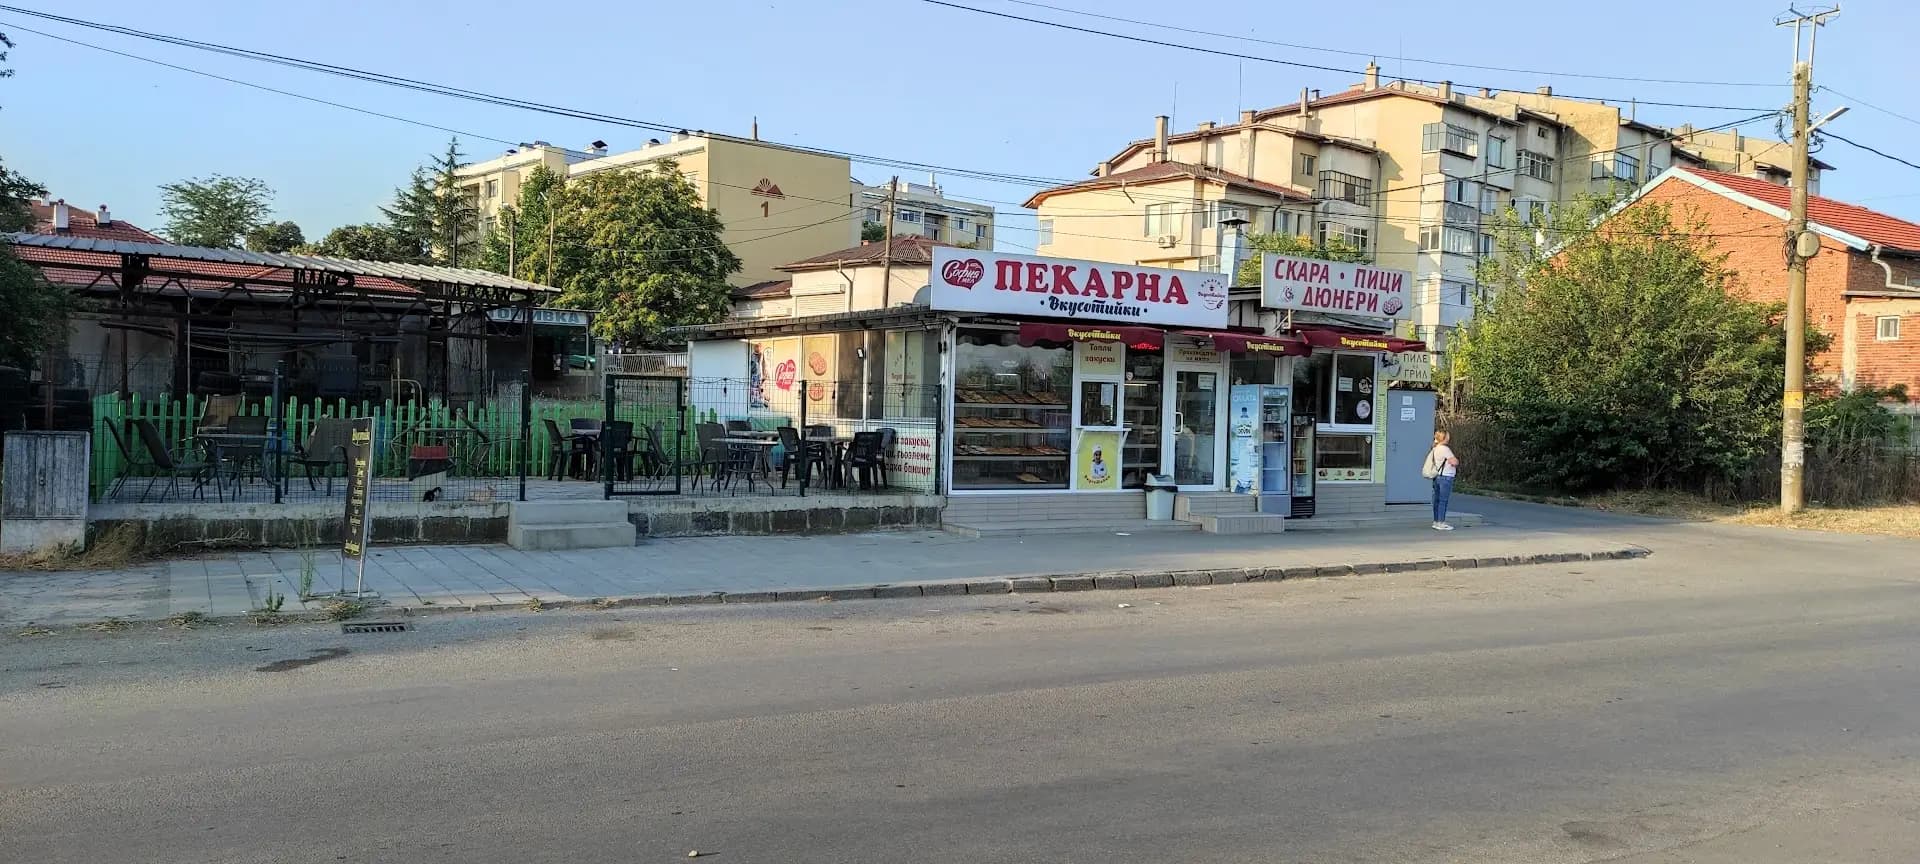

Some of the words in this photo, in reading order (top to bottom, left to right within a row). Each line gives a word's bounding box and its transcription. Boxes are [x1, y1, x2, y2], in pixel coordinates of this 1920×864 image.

[761, 200, 769, 218] 1
[943, 260, 981, 285] София
[1274, 258, 1330, 285] СКАРА
[1354, 267, 1404, 295] ПИЦИ
[994, 259, 1189, 305] ПЕКАРНА
[1048, 295, 1142, 317] Вкусотийки
[1301, 286, 1379, 313] ДЮНЕРИ
[1067, 328, 1121, 341] Вкусотийки
[1089, 342, 1112, 352] Топли
[1245, 340, 1285, 353] Вкусотийки
[1340, 336, 1388, 350] Вкусотийки
[1085, 355, 1116, 365] закуски
[1403, 353, 1428, 364] ПИЛЕ
[1404, 369, 1428, 379] ГРИЛ
